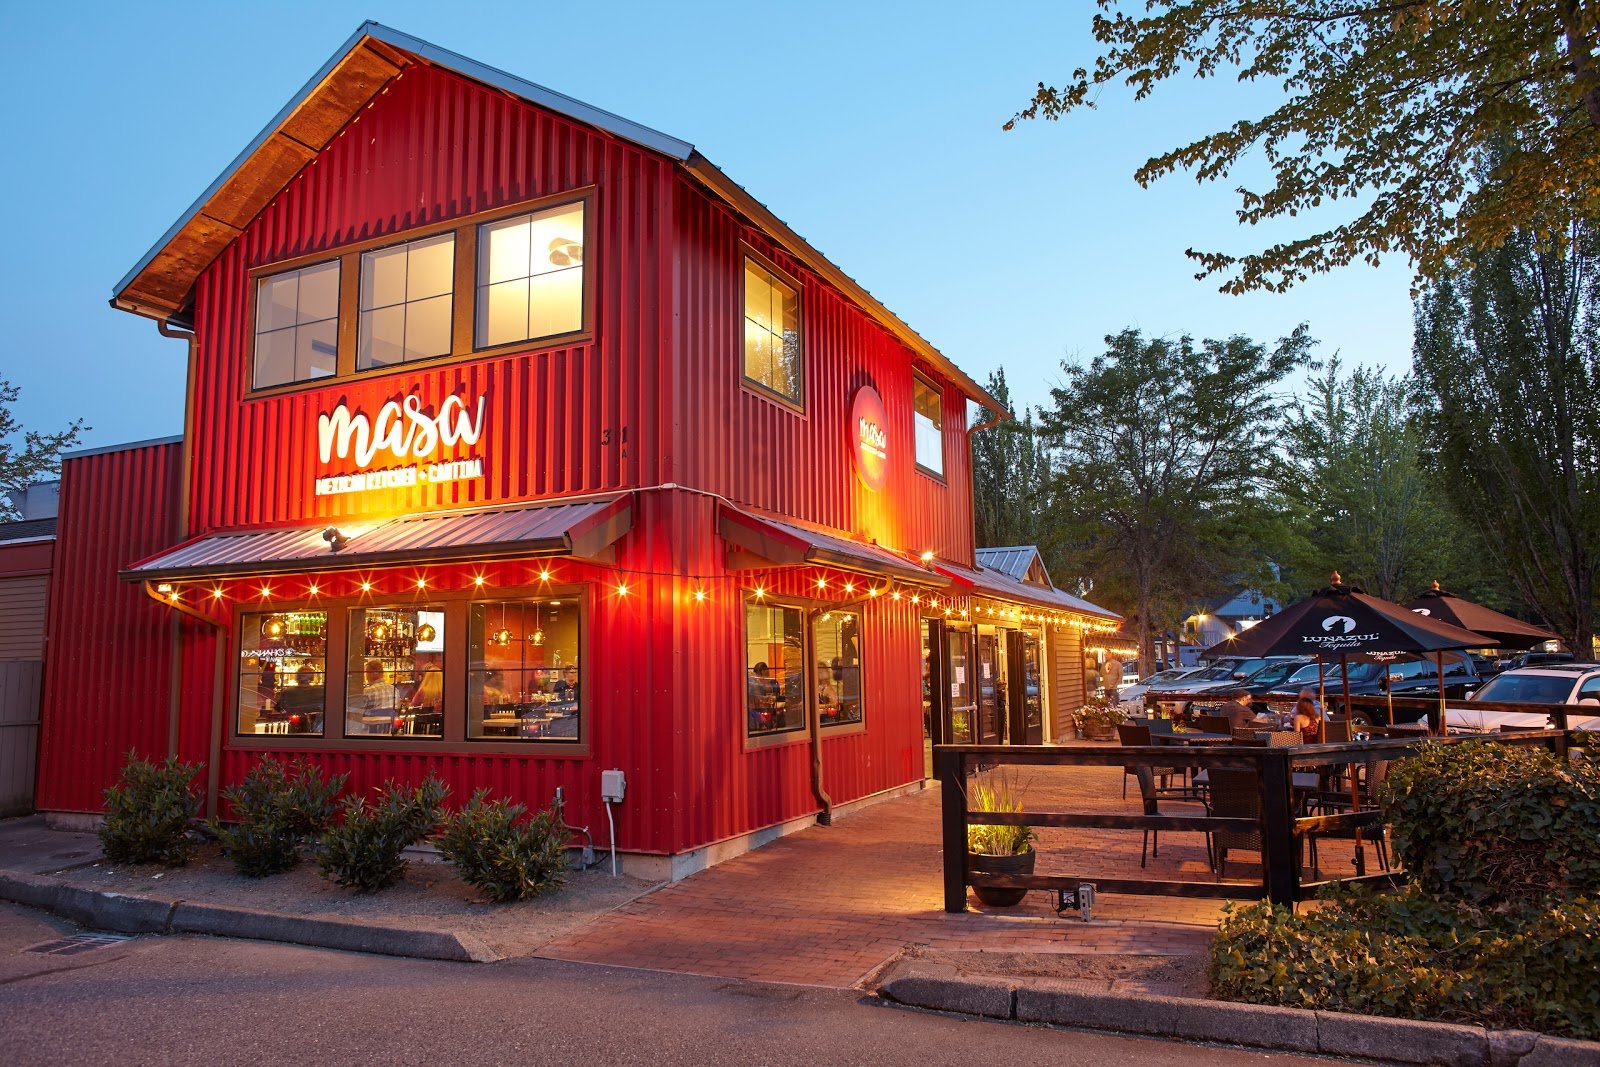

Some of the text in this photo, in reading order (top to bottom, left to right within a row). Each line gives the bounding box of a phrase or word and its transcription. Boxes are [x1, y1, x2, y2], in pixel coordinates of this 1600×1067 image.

[318, 394, 485, 467] masa
[315, 472, 366, 496] MEXICAN
[366, 466, 417, 491] KITCHEN
[428, 459, 483, 483] CANTINA
[1302, 633, 1379, 643] LUNAZUL
[1319, 640, 1362, 650] Tequila
